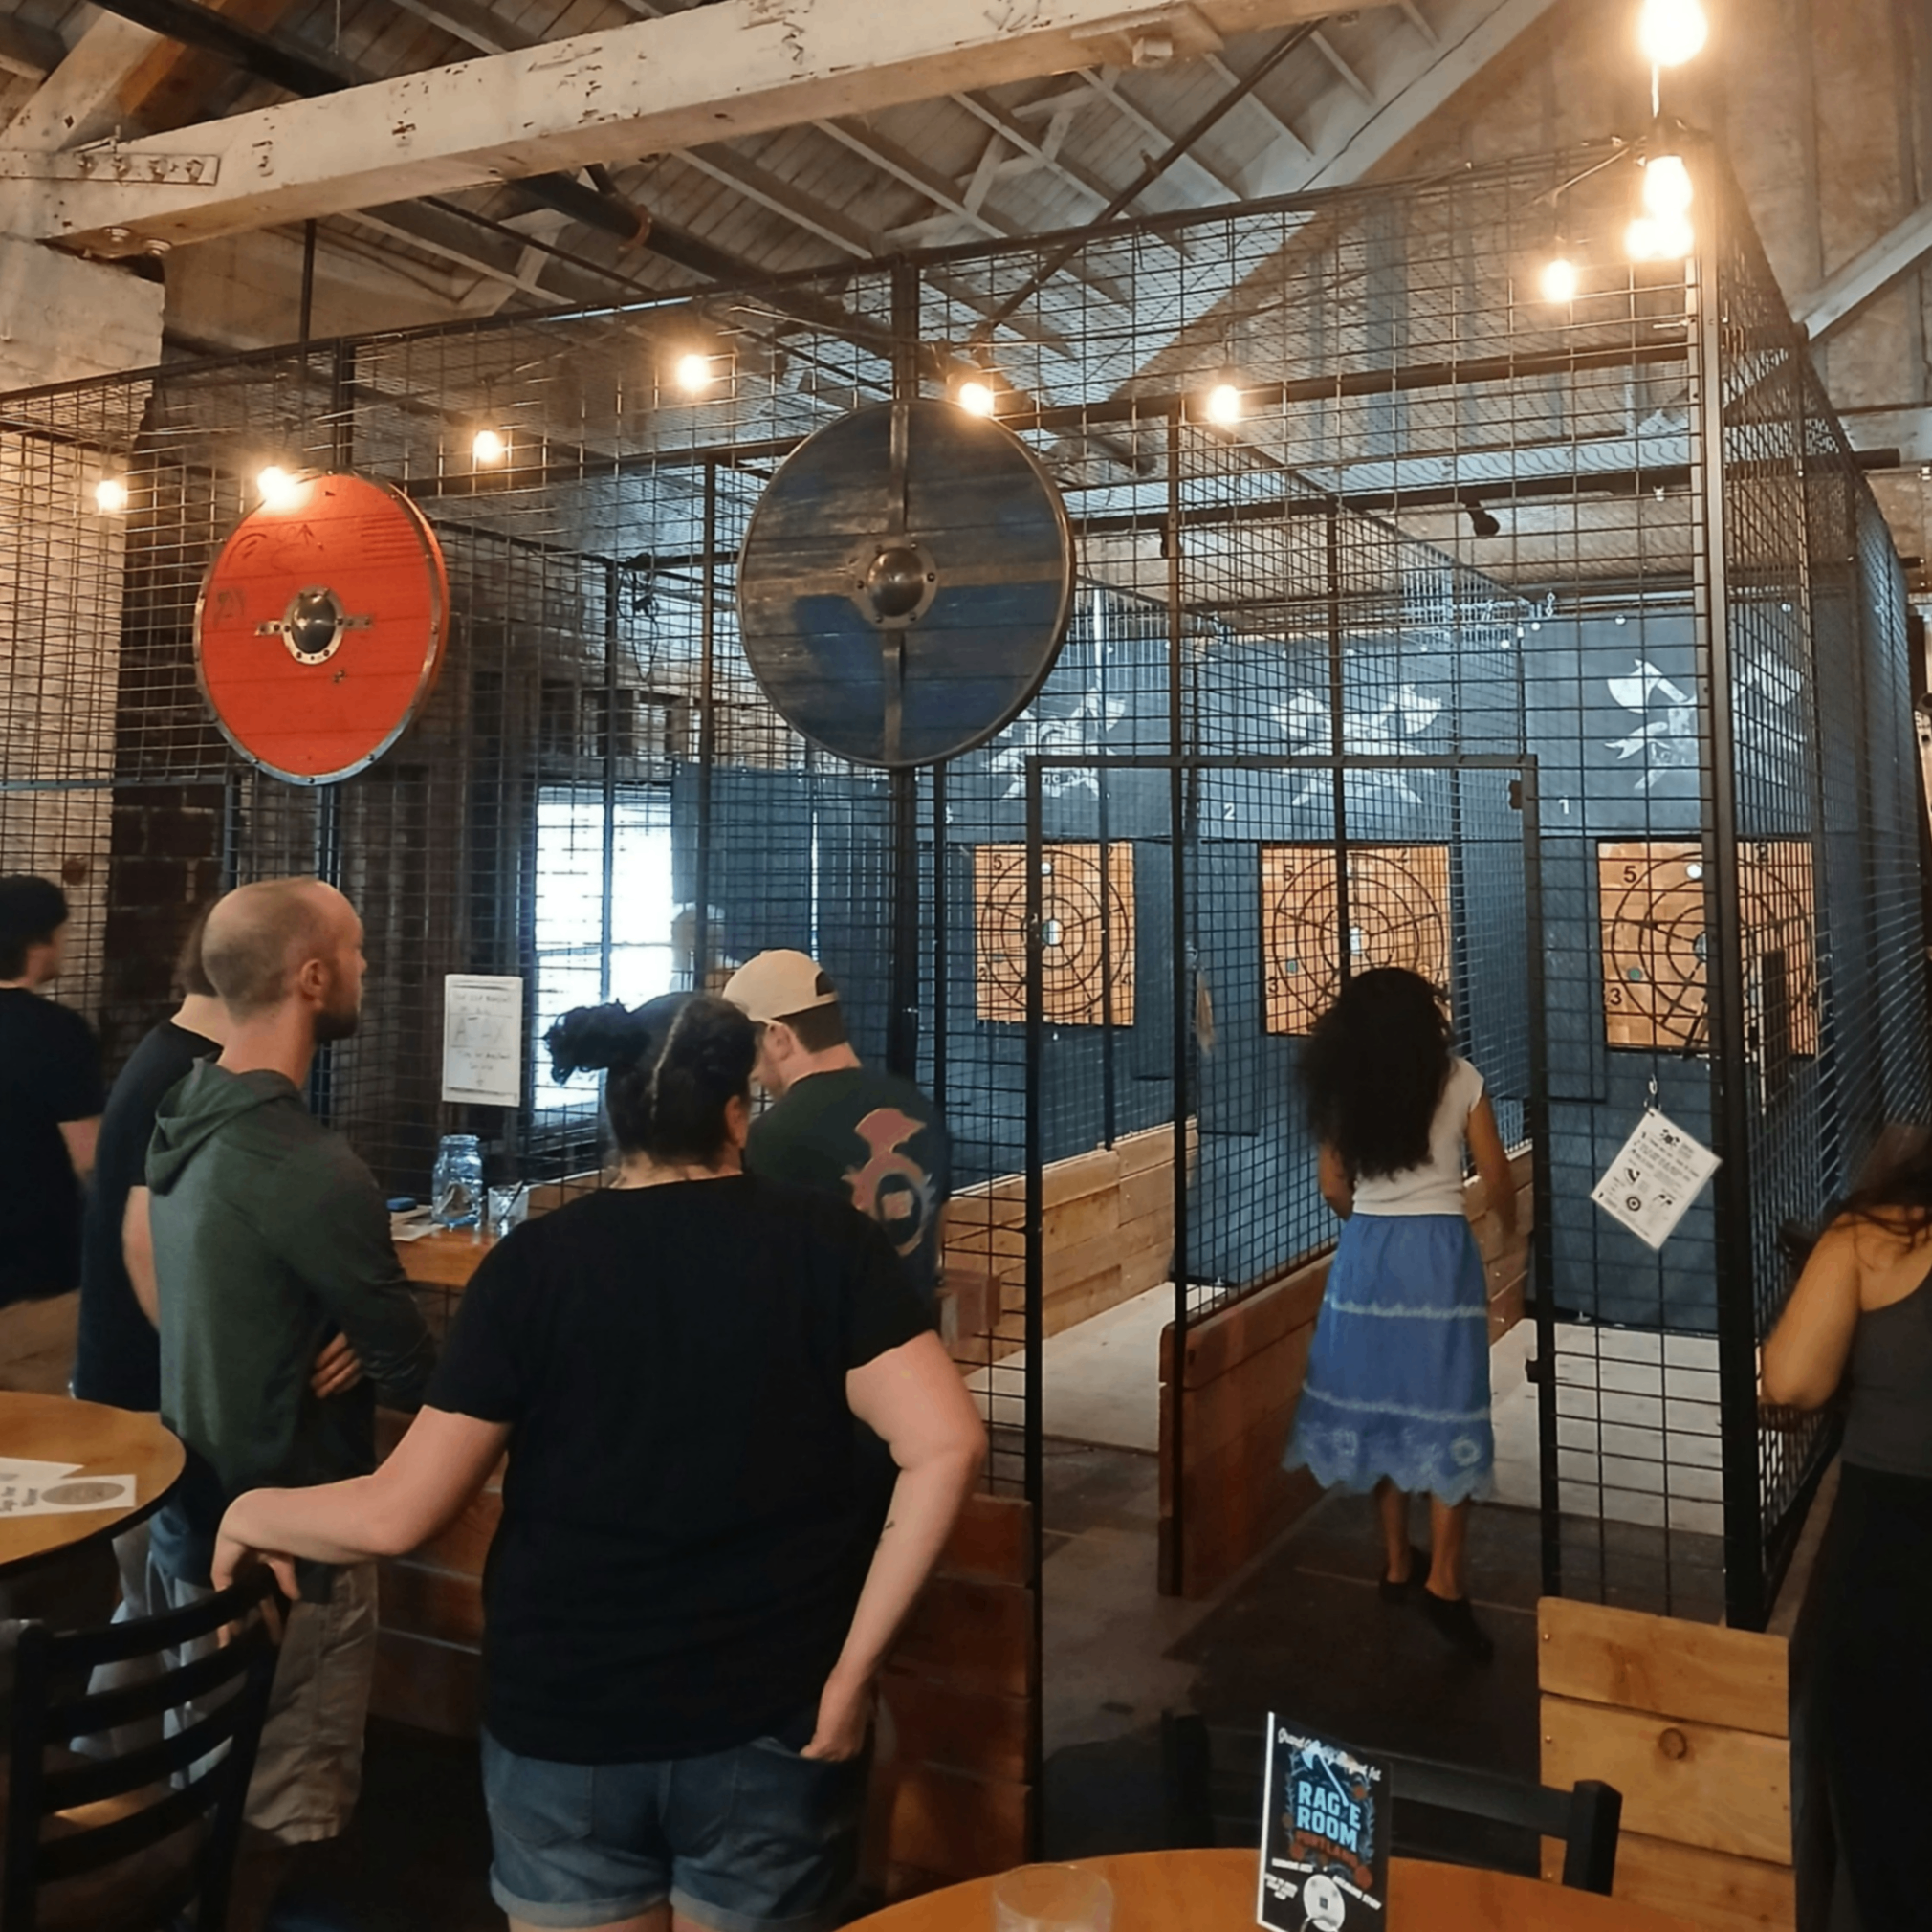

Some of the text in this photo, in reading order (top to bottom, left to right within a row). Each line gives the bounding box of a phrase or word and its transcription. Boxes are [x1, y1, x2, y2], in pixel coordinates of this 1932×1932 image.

[1223, 802, 1236, 820] 2
[1558, 794, 1570, 815] 1
[992, 854, 1003, 869] 5
[1284, 865, 1296, 882] 5
[1623, 865, 1636, 883] 5
[1610, 987, 1623, 1006] 3
[1298, 1781, 1361, 1830] RAGE
[1296, 1806, 1358, 1853] ROOM
